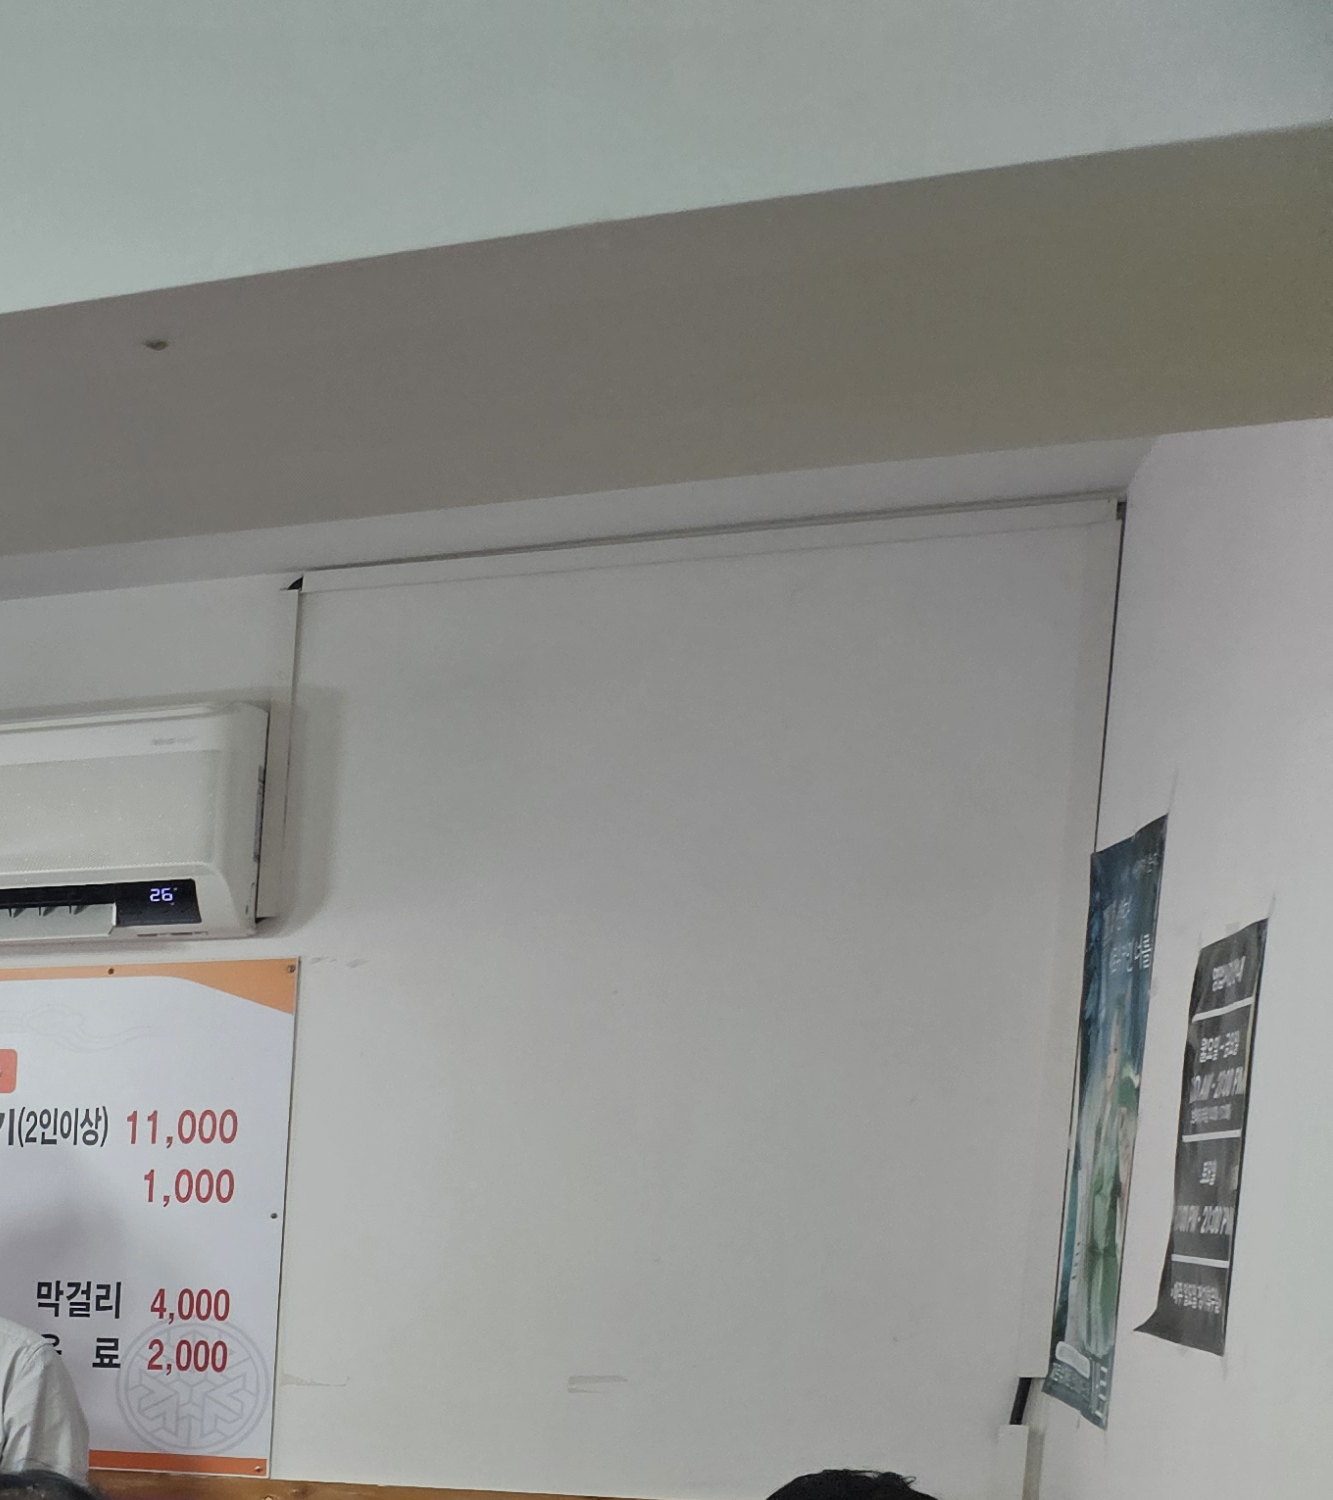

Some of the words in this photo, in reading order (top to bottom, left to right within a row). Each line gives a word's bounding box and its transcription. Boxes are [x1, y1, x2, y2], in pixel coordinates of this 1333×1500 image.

[126, 1109, 239, 1149] 11,000
[143, 1168, 235, 1207] 1,000
[36, 1280, 122, 1319] 막걸리
[150, 1288, 230, 1325] 4,000
[147, 1338, 228, 1376] 2,000
